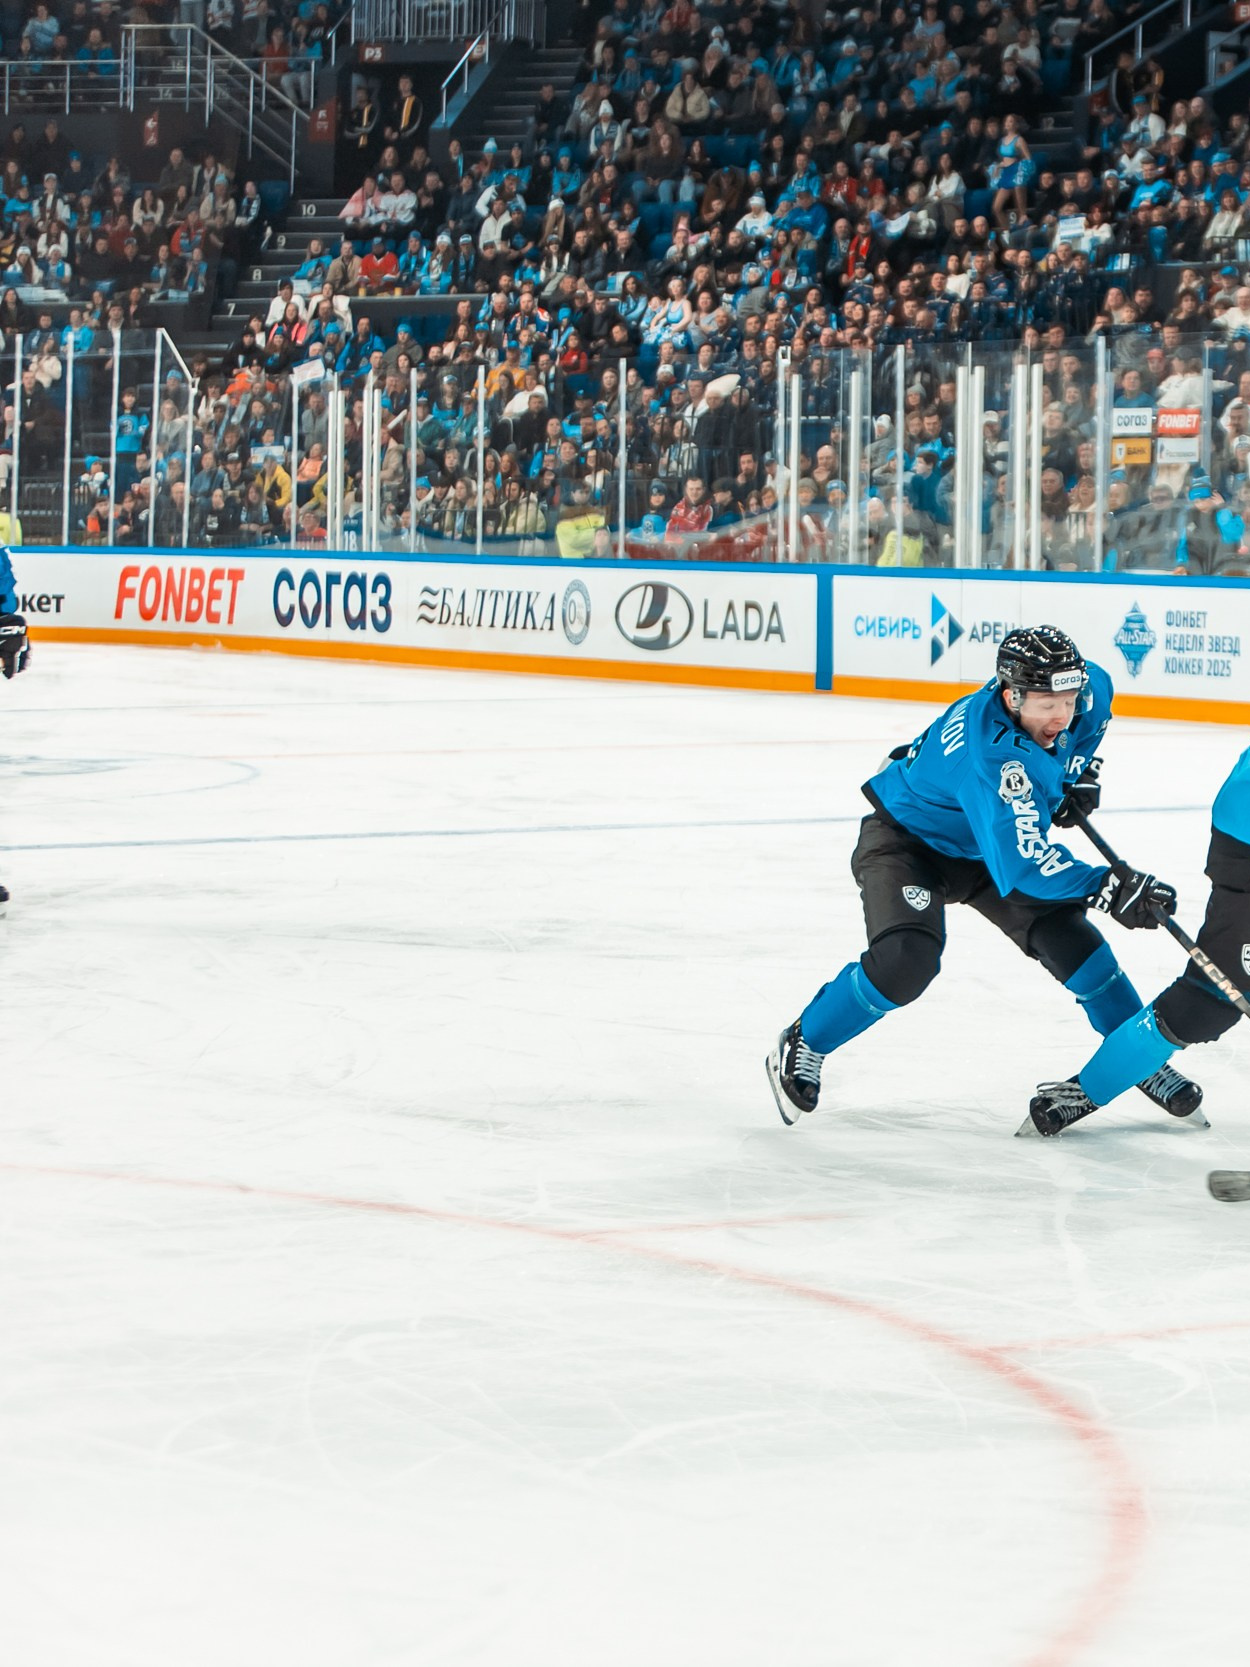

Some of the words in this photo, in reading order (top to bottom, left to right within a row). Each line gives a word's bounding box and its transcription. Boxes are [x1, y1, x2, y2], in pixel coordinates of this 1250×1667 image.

[302, 204, 316, 216] 10
[277, 235, 286, 247] 9
[252, 269, 262, 281] 8
[227, 303, 236, 317] 7
[1159, 414, 1199, 428] FONBET
[114, 565, 245, 625] FONBET
[437, 586, 556, 631] БАЛТИКА
[1166, 610, 1207, 628] ФОНБЕТ
[703, 598, 787, 643] LADA
[854, 614, 922, 640] СИБИРЬ
[968, 621, 1023, 644] АРЕН
[1165, 633, 1204, 653] НЕДЕЛЯ
[1208, 635, 1240, 656] ЗВЕЗД
[1164, 656, 1203, 676] ХОККЕЯ
[1206, 659, 1232, 677] 2025
